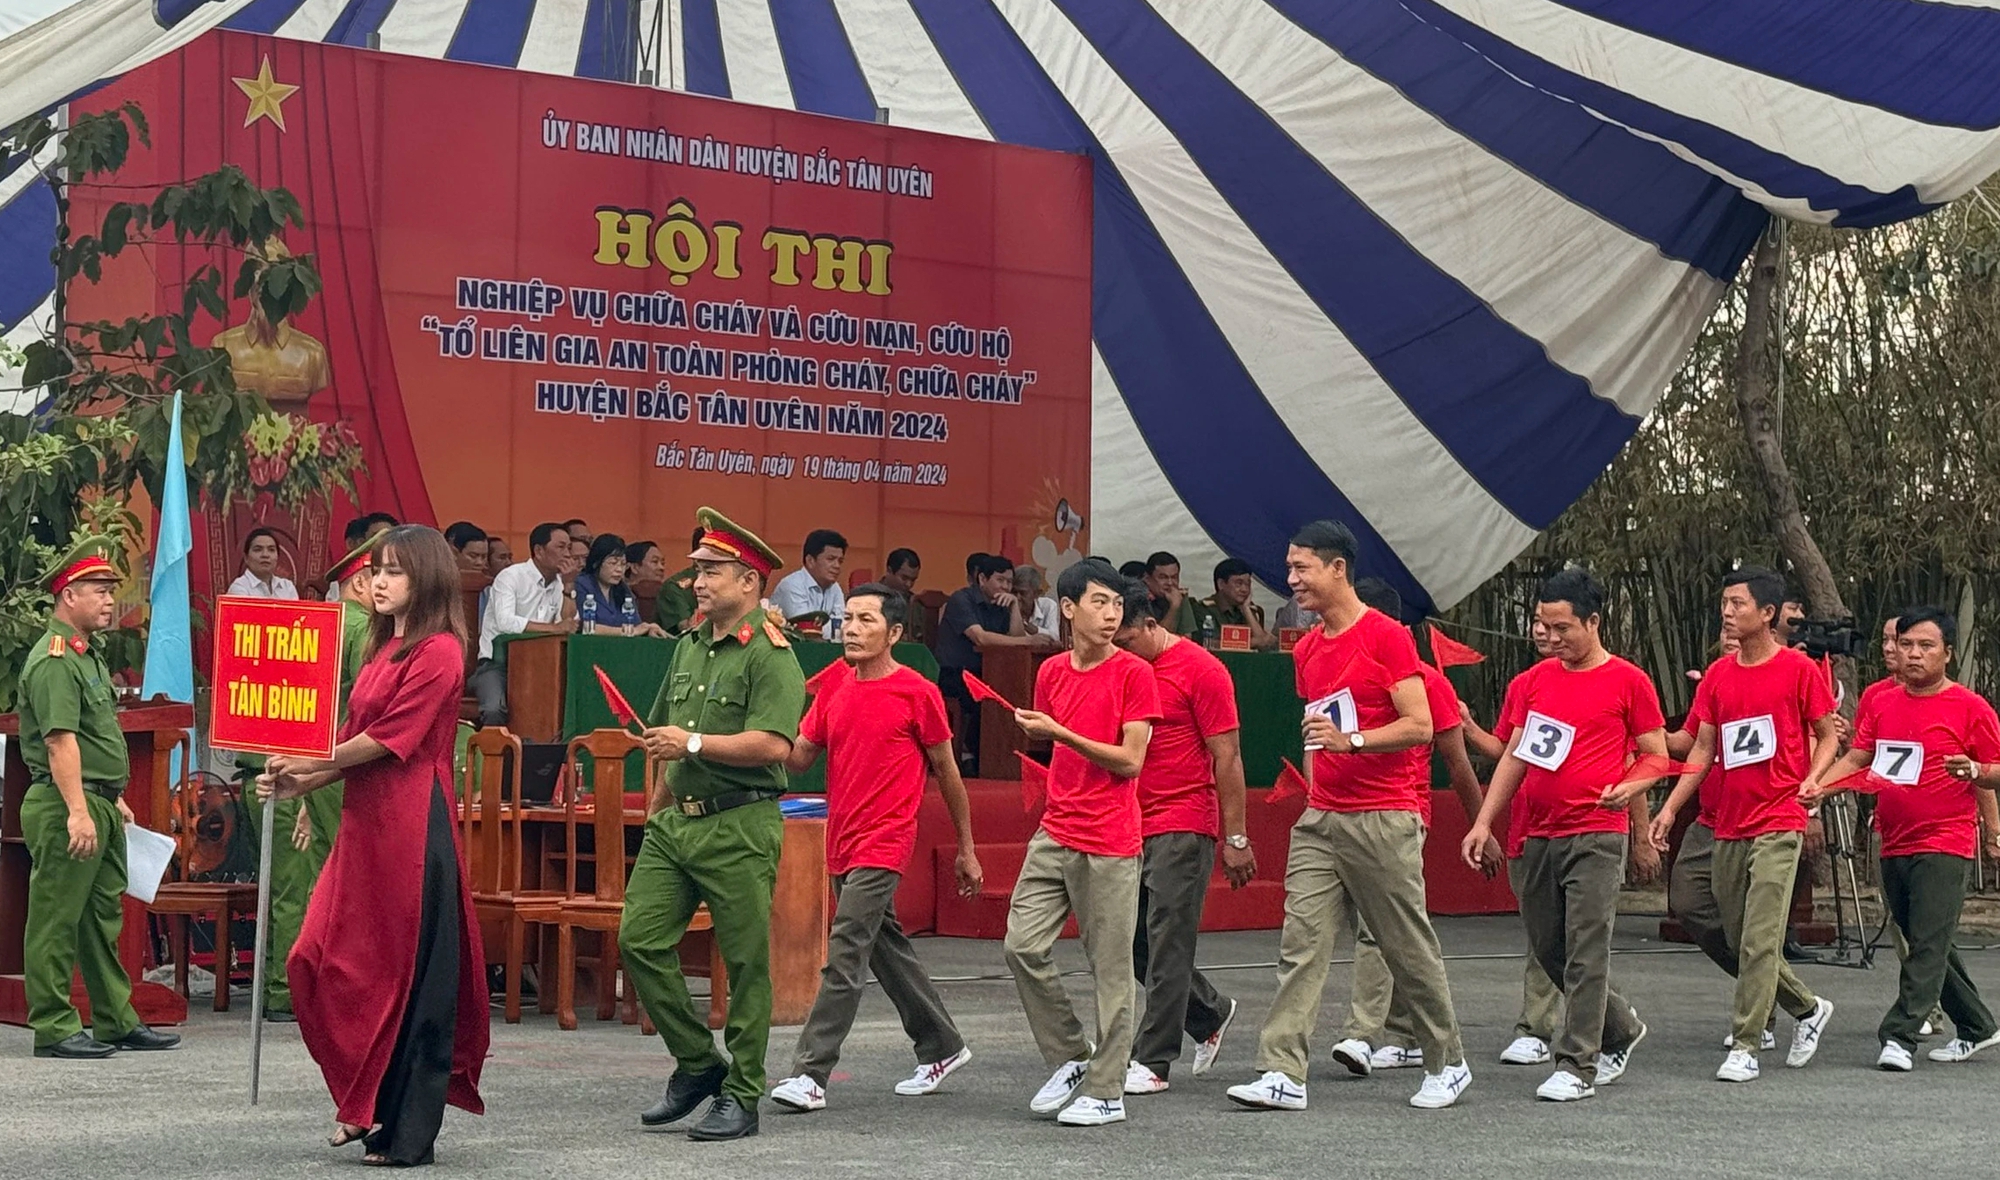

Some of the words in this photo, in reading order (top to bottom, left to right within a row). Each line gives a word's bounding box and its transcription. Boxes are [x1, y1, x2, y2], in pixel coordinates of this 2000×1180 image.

[543, 110, 571, 149] ỦY
[577, 123, 619, 155] BAN
[626, 128, 683, 164] NHÂN
[689, 135, 729, 171] DÂN
[735, 146, 798, 183] HUYỆN
[803, 149, 841, 186] BẮC
[847, 161, 882, 192] TÂN
[886, 165, 933, 198] UYÊN
[593, 197, 742, 286] HỘI
[761, 226, 894, 296] THI
[456, 277, 564, 321] NGHIỆP
[569, 287, 608, 327] VỤ
[614, 290, 688, 329] CHỮA
[694, 300, 764, 337] CHÁY
[768, 305, 803, 341] VÀ
[809, 310, 858, 346] CỨU
[864, 319, 922, 355] NẠN,
[929, 323, 976, 356] CỨU
[980, 327, 1012, 365] HỘ
[420, 316, 477, 358] “TỔ
[481, 325, 547, 362] LIÊN
[553, 336, 601, 368] GIA
[607, 339, 648, 372] AN
[655, 342, 723, 378] TOÀN
[731, 349, 819, 385] PHÒNG
[824, 358, 891, 397] CHÁY,
[897, 366, 960, 399] CHỮA
[966, 369, 1037, 404] CHÁY”
[535, 379, 627, 423] HUYỆN
[634, 380, 689, 422] BẮC
[695, 391, 748, 427] TÂN
[754, 397, 820, 433] UYÊN
[827, 402, 884, 437] NĂM
[890, 412, 948, 442] 2024
[655, 440, 685, 469] Bắc
[688, 444, 714, 471] Tân
[717, 448, 756, 477] Uyên,
[761, 452, 795, 478] ngày
[802, 459, 820, 478] 19
[822, 457, 860, 483] tháng
[864, 460, 881, 481] 04
[883, 462, 911, 484] năm
[913, 463, 947, 486] 2024
[233, 623, 261, 666] THỊ
[266, 615, 320, 663] TRẤN
[228, 675, 264, 718] TÂN
[267, 678, 318, 723] BÌNH
[1322, 700, 1342, 732] 1
[1530, 724, 1562, 758] 3
[1733, 725, 1764, 756] 4
[1886, 746, 1913, 776] 7
